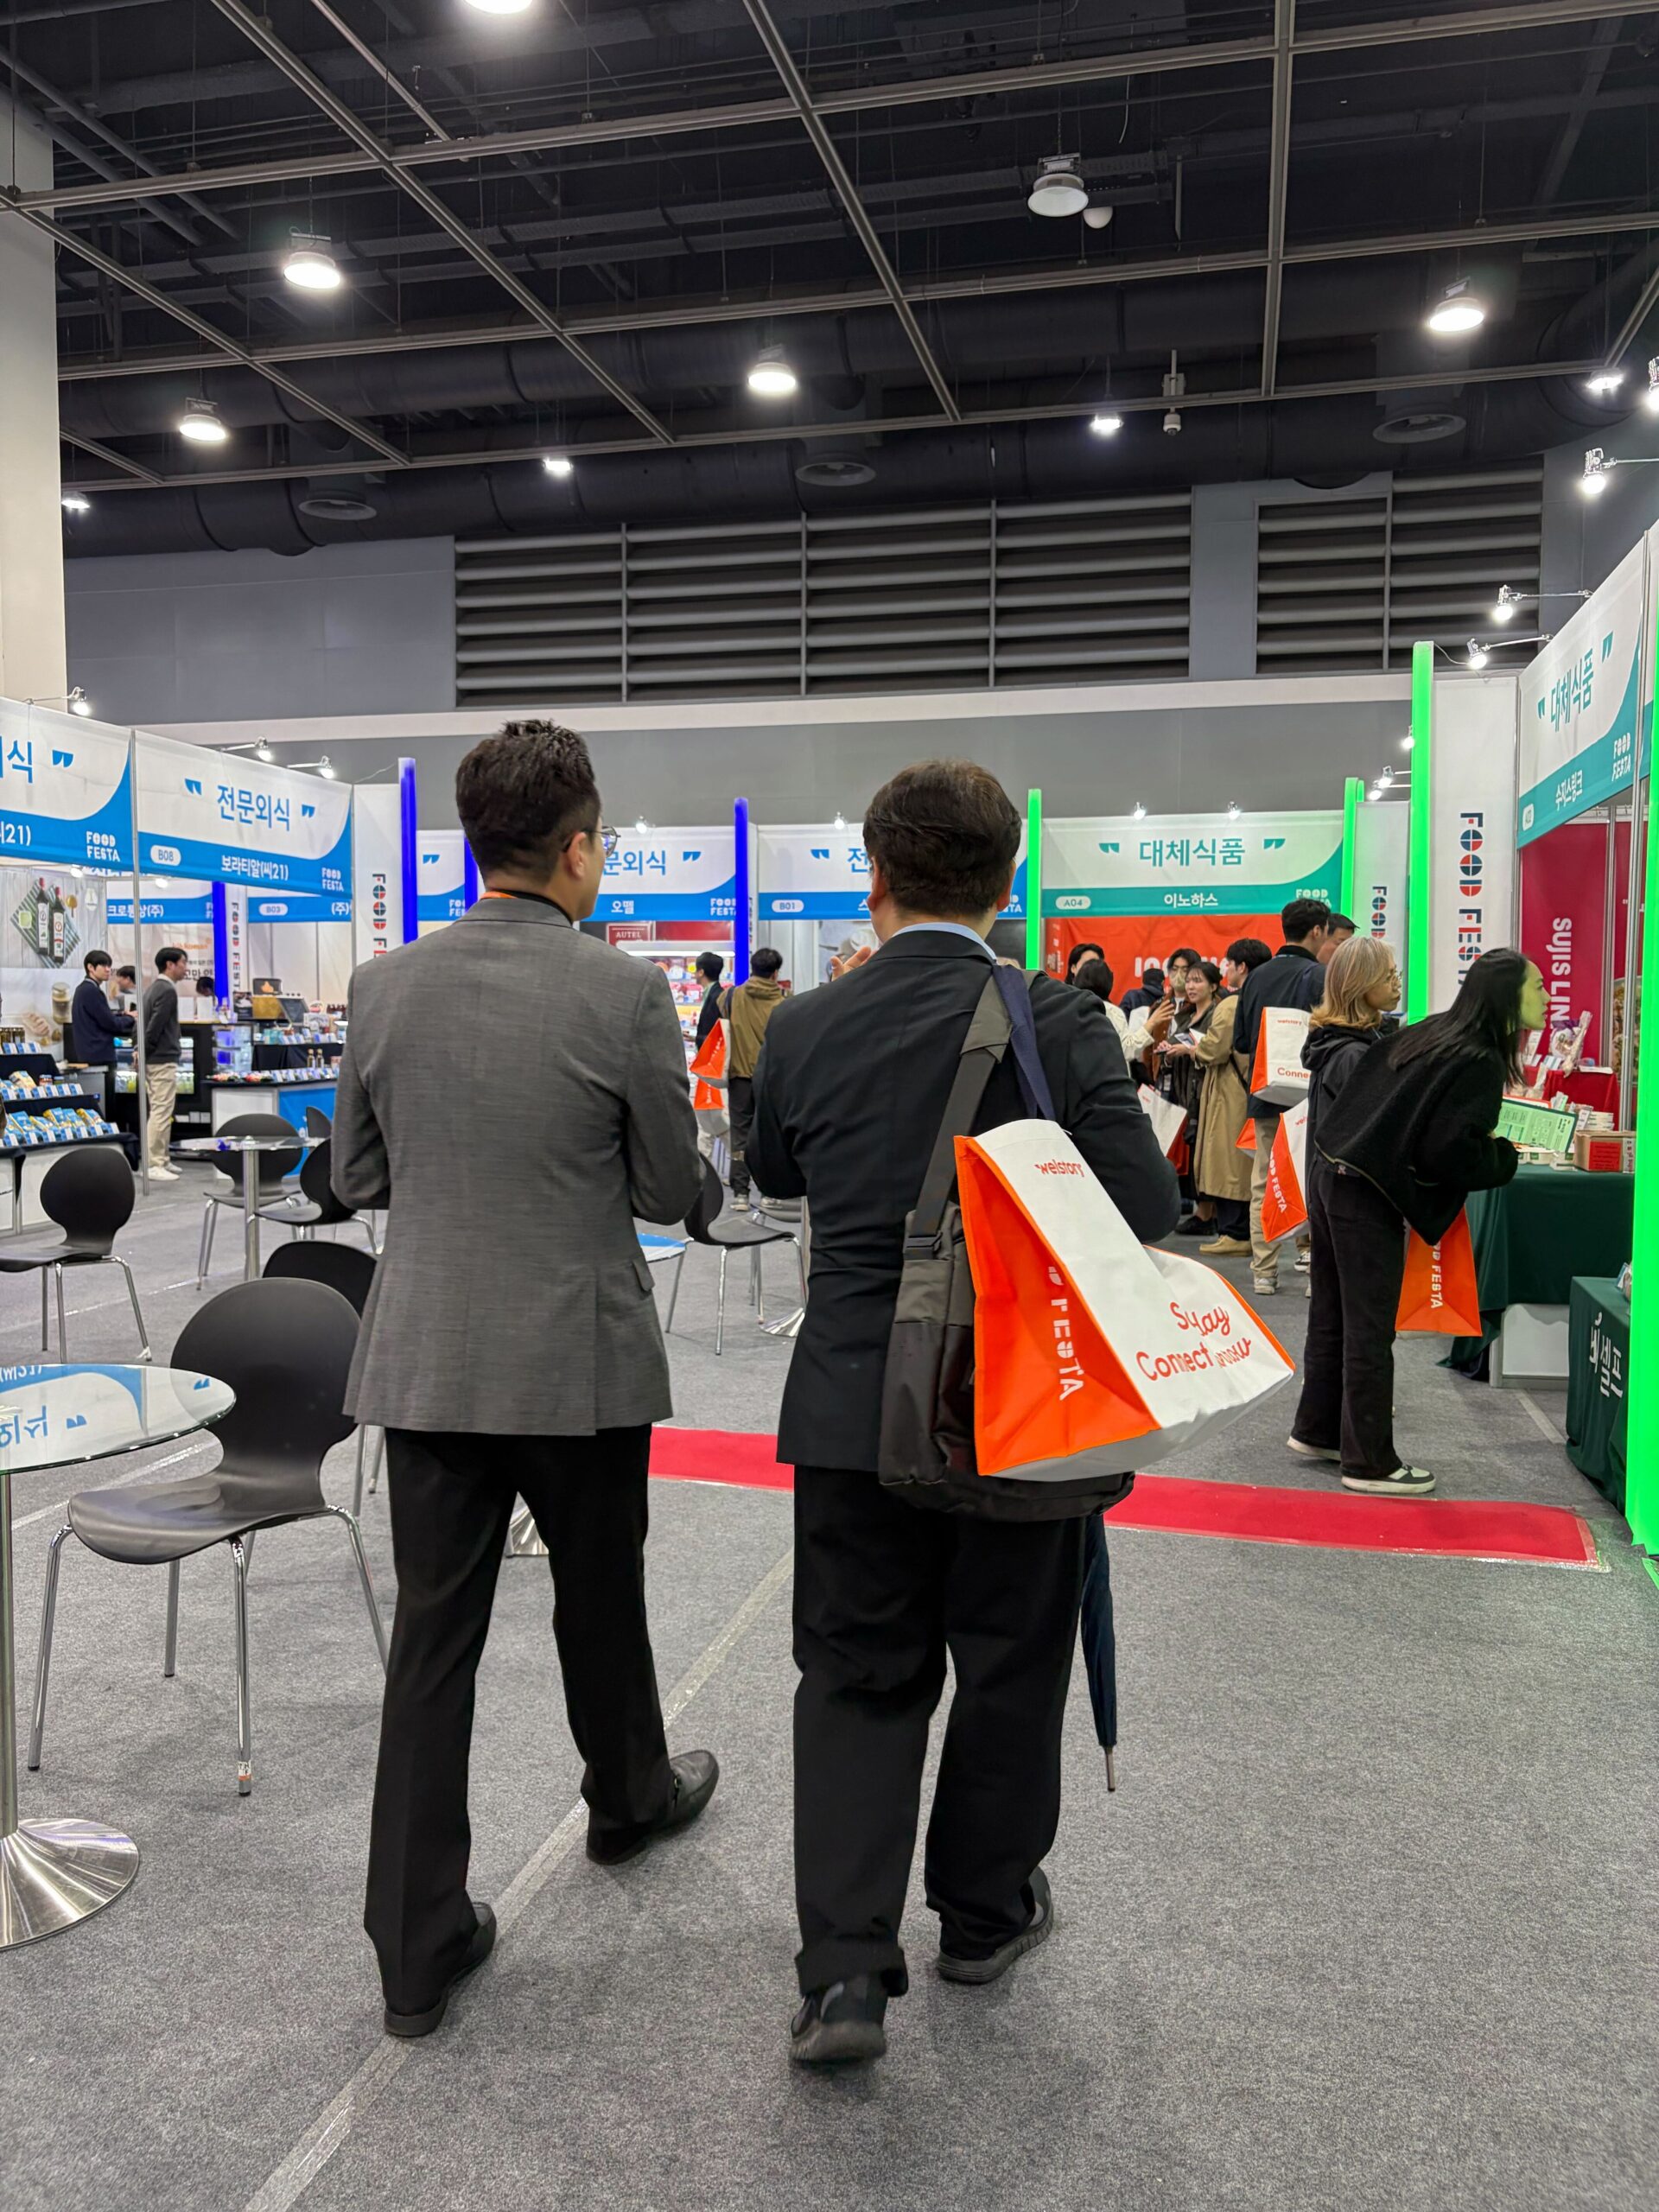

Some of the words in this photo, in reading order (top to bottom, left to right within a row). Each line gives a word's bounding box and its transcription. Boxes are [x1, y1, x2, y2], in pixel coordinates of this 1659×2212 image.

[1551, 648, 1593, 732] 대체식품
[0, 735, 33, 784] 식
[1613, 732, 1631, 760] FOOD
[1611, 753, 1631, 781] FESTA
[1555, 770, 1583, 811] 수지스링크
[217, 785, 290, 831] 전문외식
[86, 831, 116, 847] FOOD
[1140, 837, 1245, 867] 대체식품
[86, 845, 121, 862] FESTA
[157, 849, 175, 862] B08
[220, 854, 289, 881] 보라티알(씨21)
[603, 850, 666, 876] 문외식
[1459, 812, 1484, 897] FOOD
[321, 867, 342, 880] FOOD
[321, 880, 345, 893] FESTA
[372, 874, 387, 931] FOOD
[779, 901, 796, 910] B01
[1164, 893, 1218, 908] 이노하스
[1296, 889, 1329, 899] FOOD
[710, 907, 736, 916] FEST
[1371, 886, 1387, 939] FOOD
[1458, 909, 1482, 985] FES
[1551, 981, 1570, 1030] LIN
[1277, 1067, 1310, 1079] Conne
[1272, 1176, 1287, 1213] FESTA
[1430, 1264, 1444, 1309] FESTA
